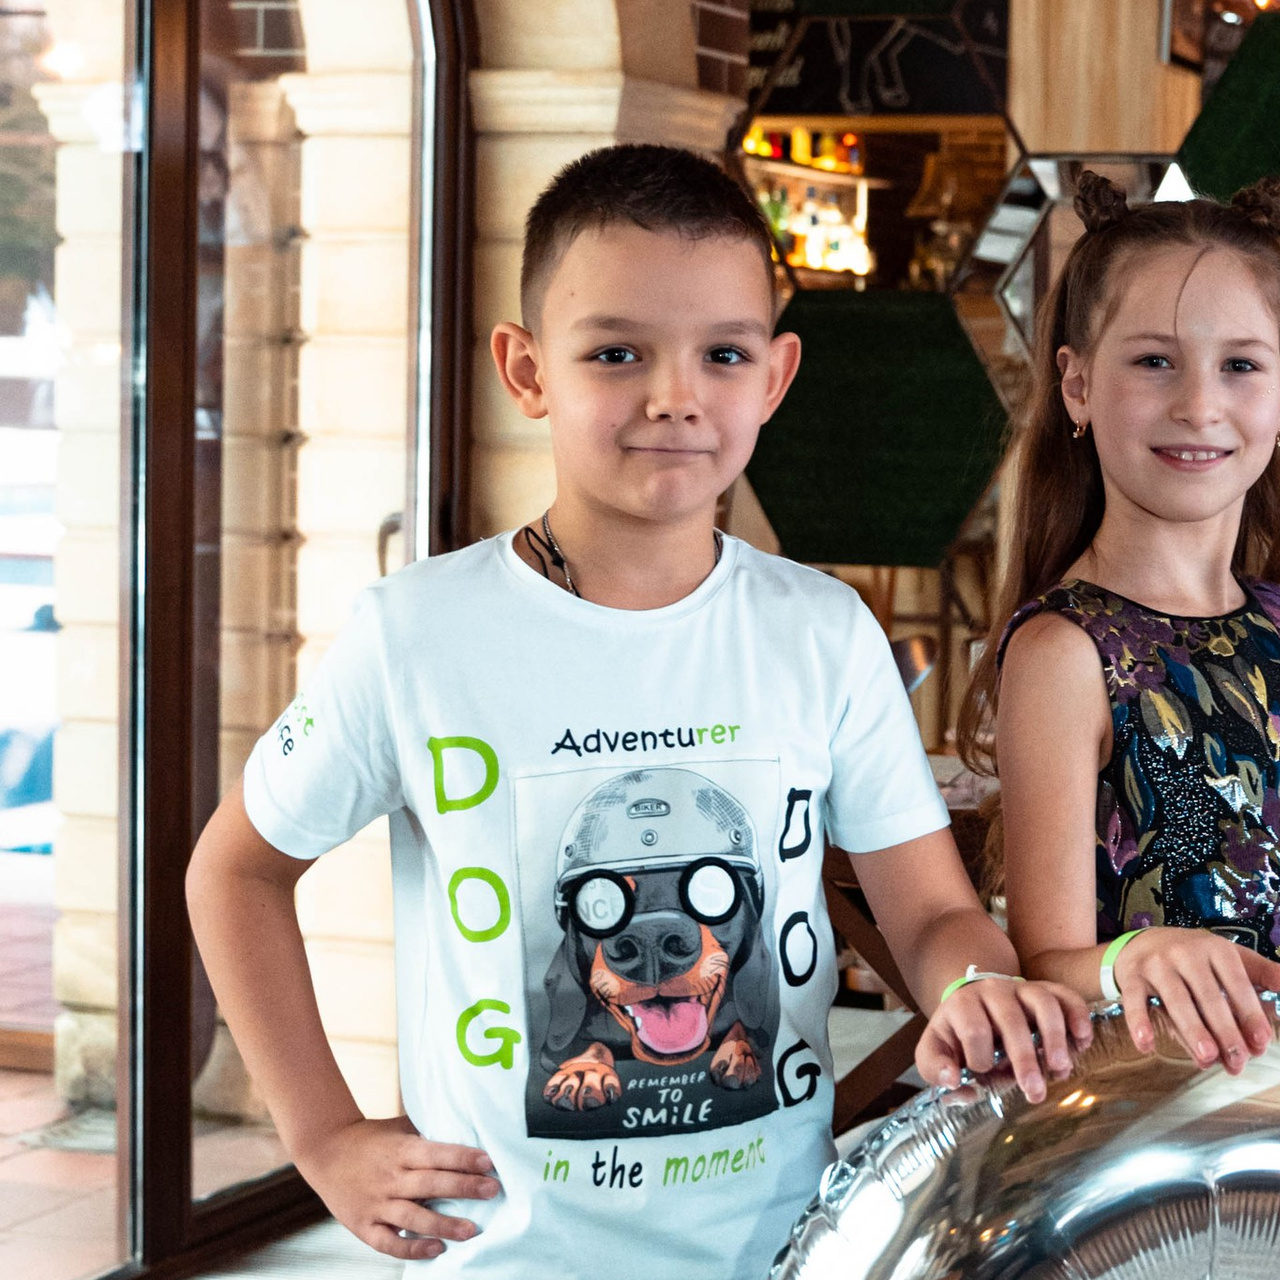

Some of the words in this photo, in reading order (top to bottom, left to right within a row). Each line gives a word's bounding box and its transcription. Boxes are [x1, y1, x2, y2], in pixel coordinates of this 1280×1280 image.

[551, 724, 741, 757] Adventurer
[427, 736, 522, 1070] DOG
[627, 1071, 706, 1090] REMEMBER
[658, 1088, 683, 1104] TO
[543, 1150, 570, 1183] in
[591, 1145, 643, 1189] the
[662, 1134, 766, 1187] moment
